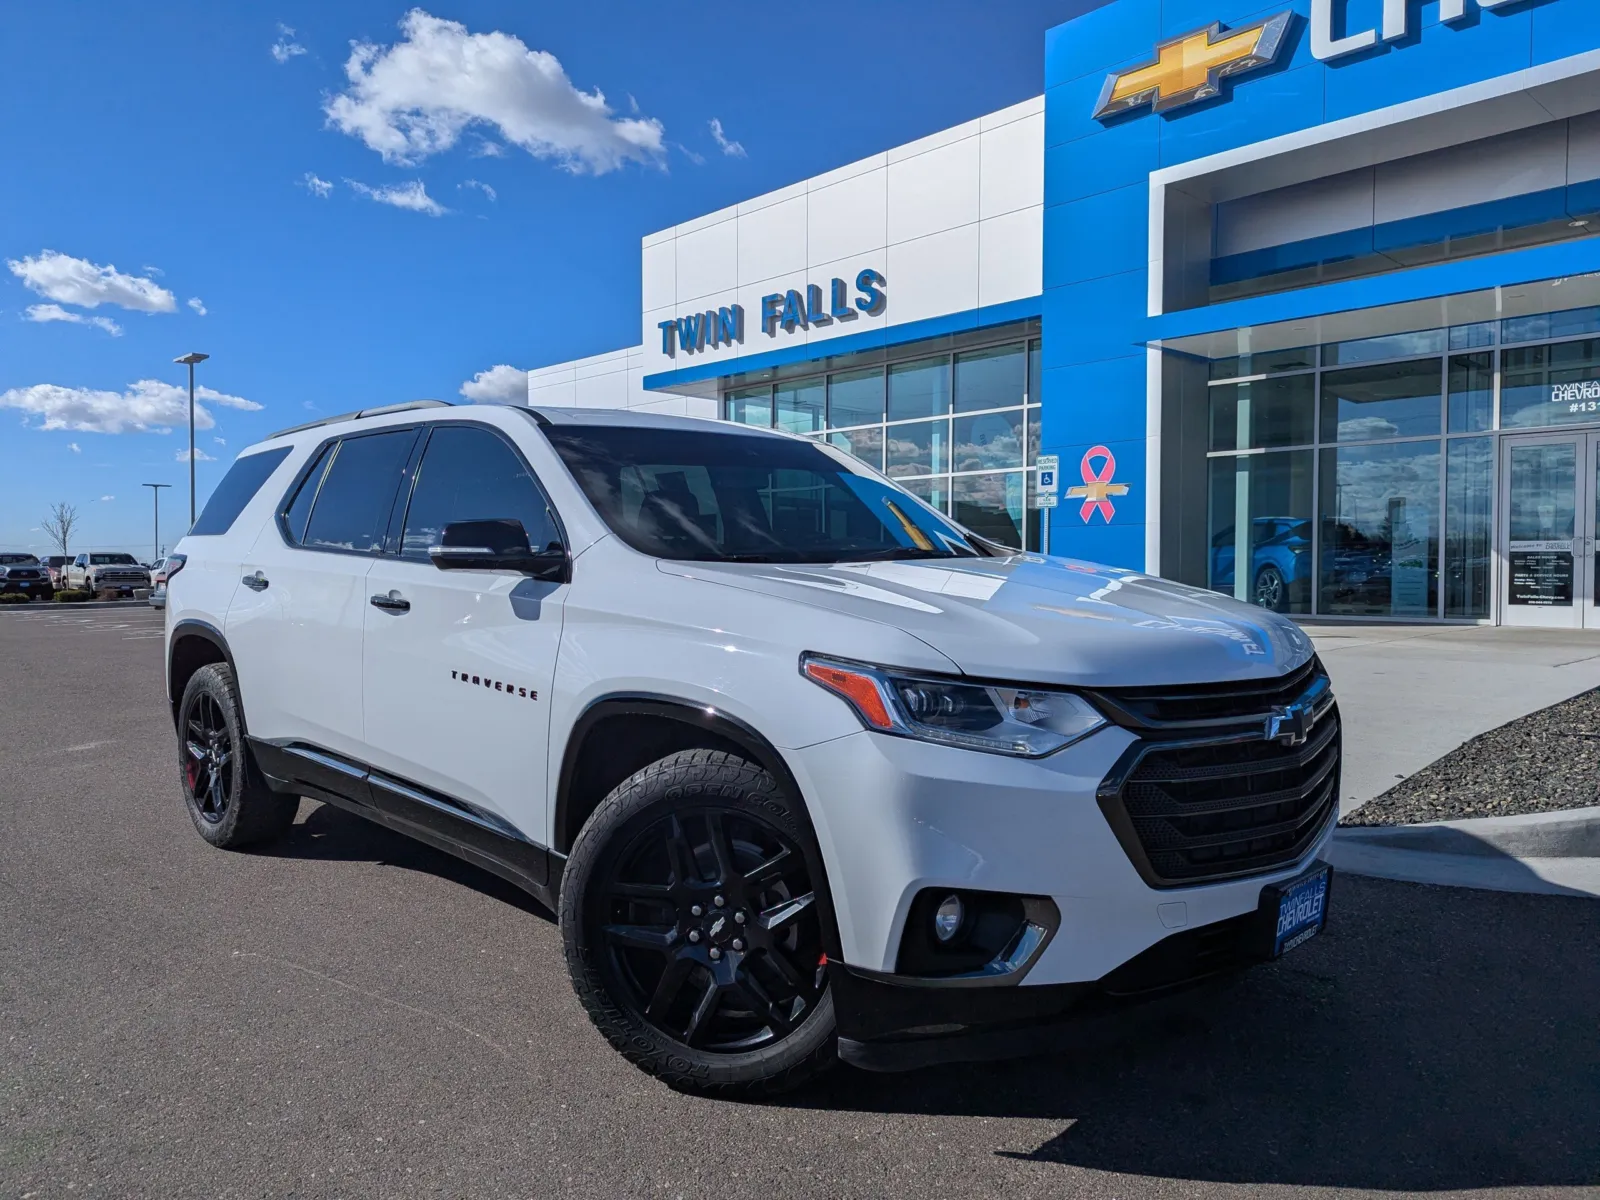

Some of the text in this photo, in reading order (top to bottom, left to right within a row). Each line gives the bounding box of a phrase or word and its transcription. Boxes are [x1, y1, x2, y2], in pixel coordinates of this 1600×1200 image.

[657, 268, 887, 359] TWIN FALLS
[451, 670, 538, 701] TRAVERSE
[1276, 893, 1324, 937] CHEVROLET
